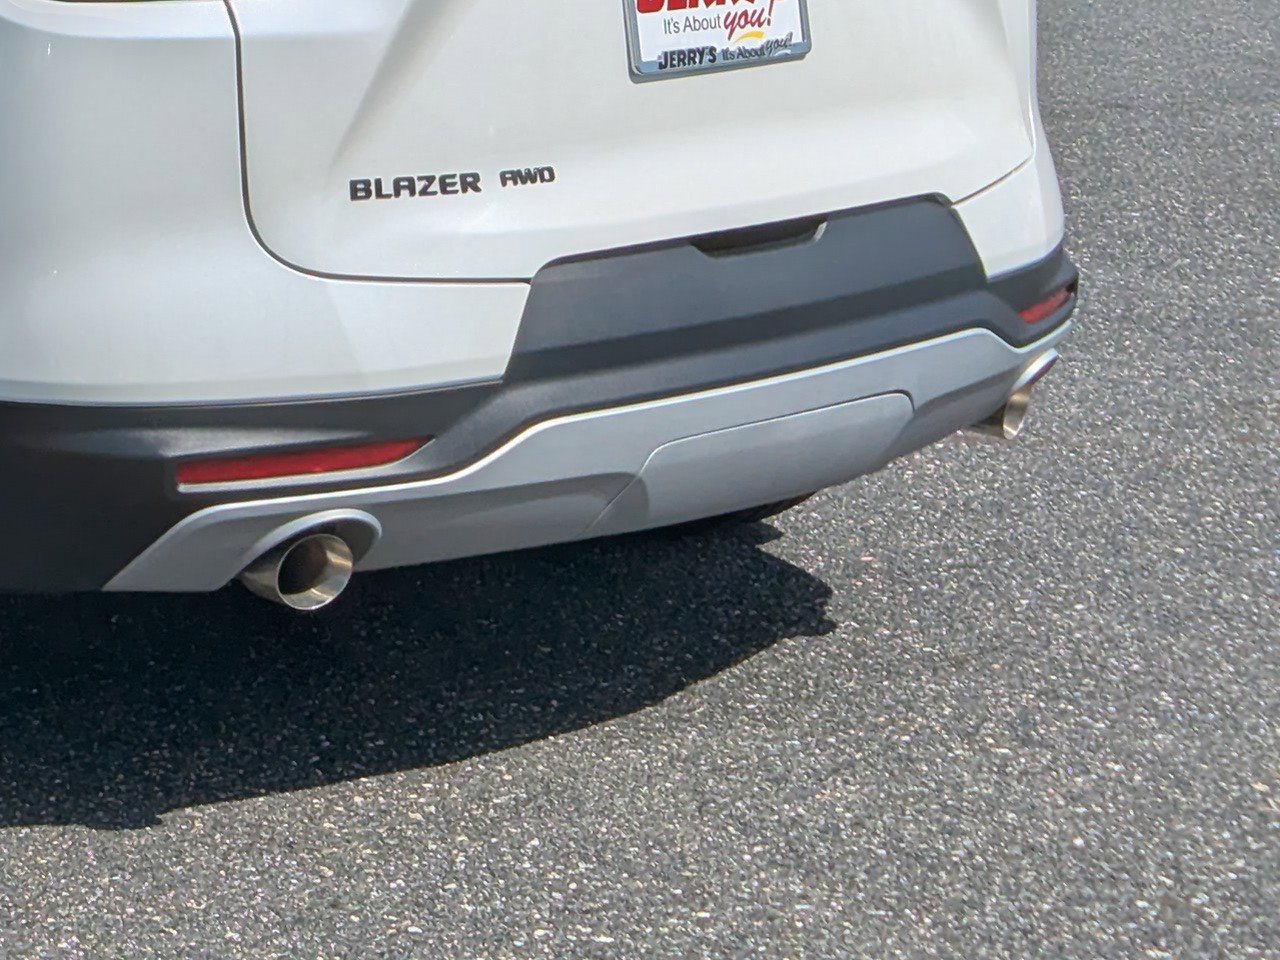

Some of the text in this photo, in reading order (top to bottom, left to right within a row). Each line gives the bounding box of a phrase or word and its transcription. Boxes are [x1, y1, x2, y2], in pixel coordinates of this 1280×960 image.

[663, 17, 680, 35] It's
[683, 15, 721, 33] About
[658, 46, 718, 70] JERRY'S
[737, 45, 766, 59] About
[349, 166, 556, 201] BLAZER AWD
